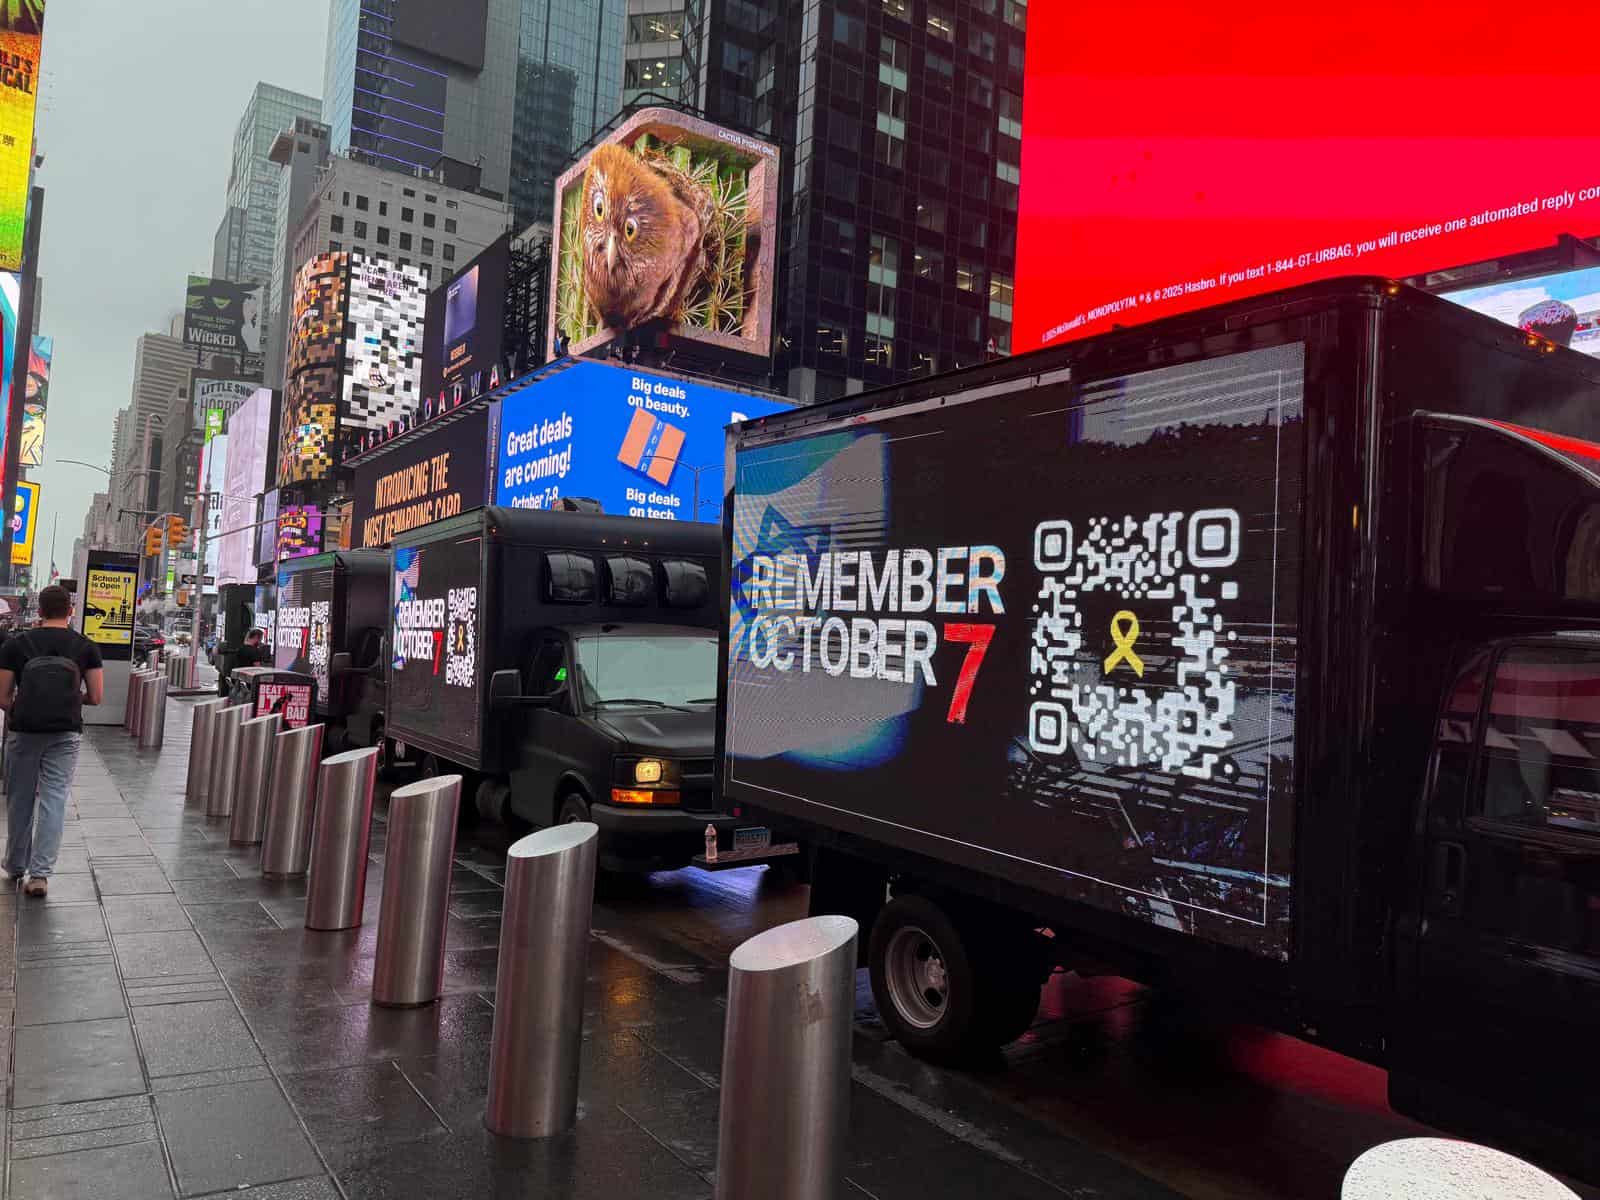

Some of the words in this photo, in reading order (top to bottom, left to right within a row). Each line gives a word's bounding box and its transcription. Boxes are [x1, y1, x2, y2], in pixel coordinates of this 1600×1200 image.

[1162, 283, 1183, 300] 2025
[1219, 272, 1227, 286] If
[1228, 271, 1245, 288] you
[1246, 264, 1265, 280] text
[1356, 240, 1376, 257] you
[1378, 231, 1398, 249] will
[1400, 223, 1442, 245] receive
[1444, 217, 1468, 234] one
[1470, 197, 1539, 228] automated
[1541, 190, 1576, 211] reply
[201, 383, 232, 396] LITTLE
[631, 376, 652, 395] Big
[653, 382, 686, 400] deals
[627, 394, 643, 408] on
[645, 395, 690, 419] beauty.
[507, 423, 538, 457] Great
[539, 410, 573, 447] deals
[374, 459, 430, 511] INTRODUCING
[430, 451, 450, 493] THE
[504, 463, 524, 489] are
[524, 443, 572, 479] coming!
[626, 487, 646, 504] Big
[647, 490, 681, 507] deals
[629, 506, 645, 518] on
[362, 513, 385, 549] MOST
[92, 574, 121, 584] School
[100, 582, 121, 591] Open
[750, 544, 1006, 615] REMEMBER
[398, 598, 446, 628] REMEMBER
[397, 630, 433, 661] OCTOBER
[432, 631, 444, 676] 7
[750, 615, 938, 687] OCTOBER
[943, 621, 997, 725] 7
[286, 706, 307, 721] BAD
